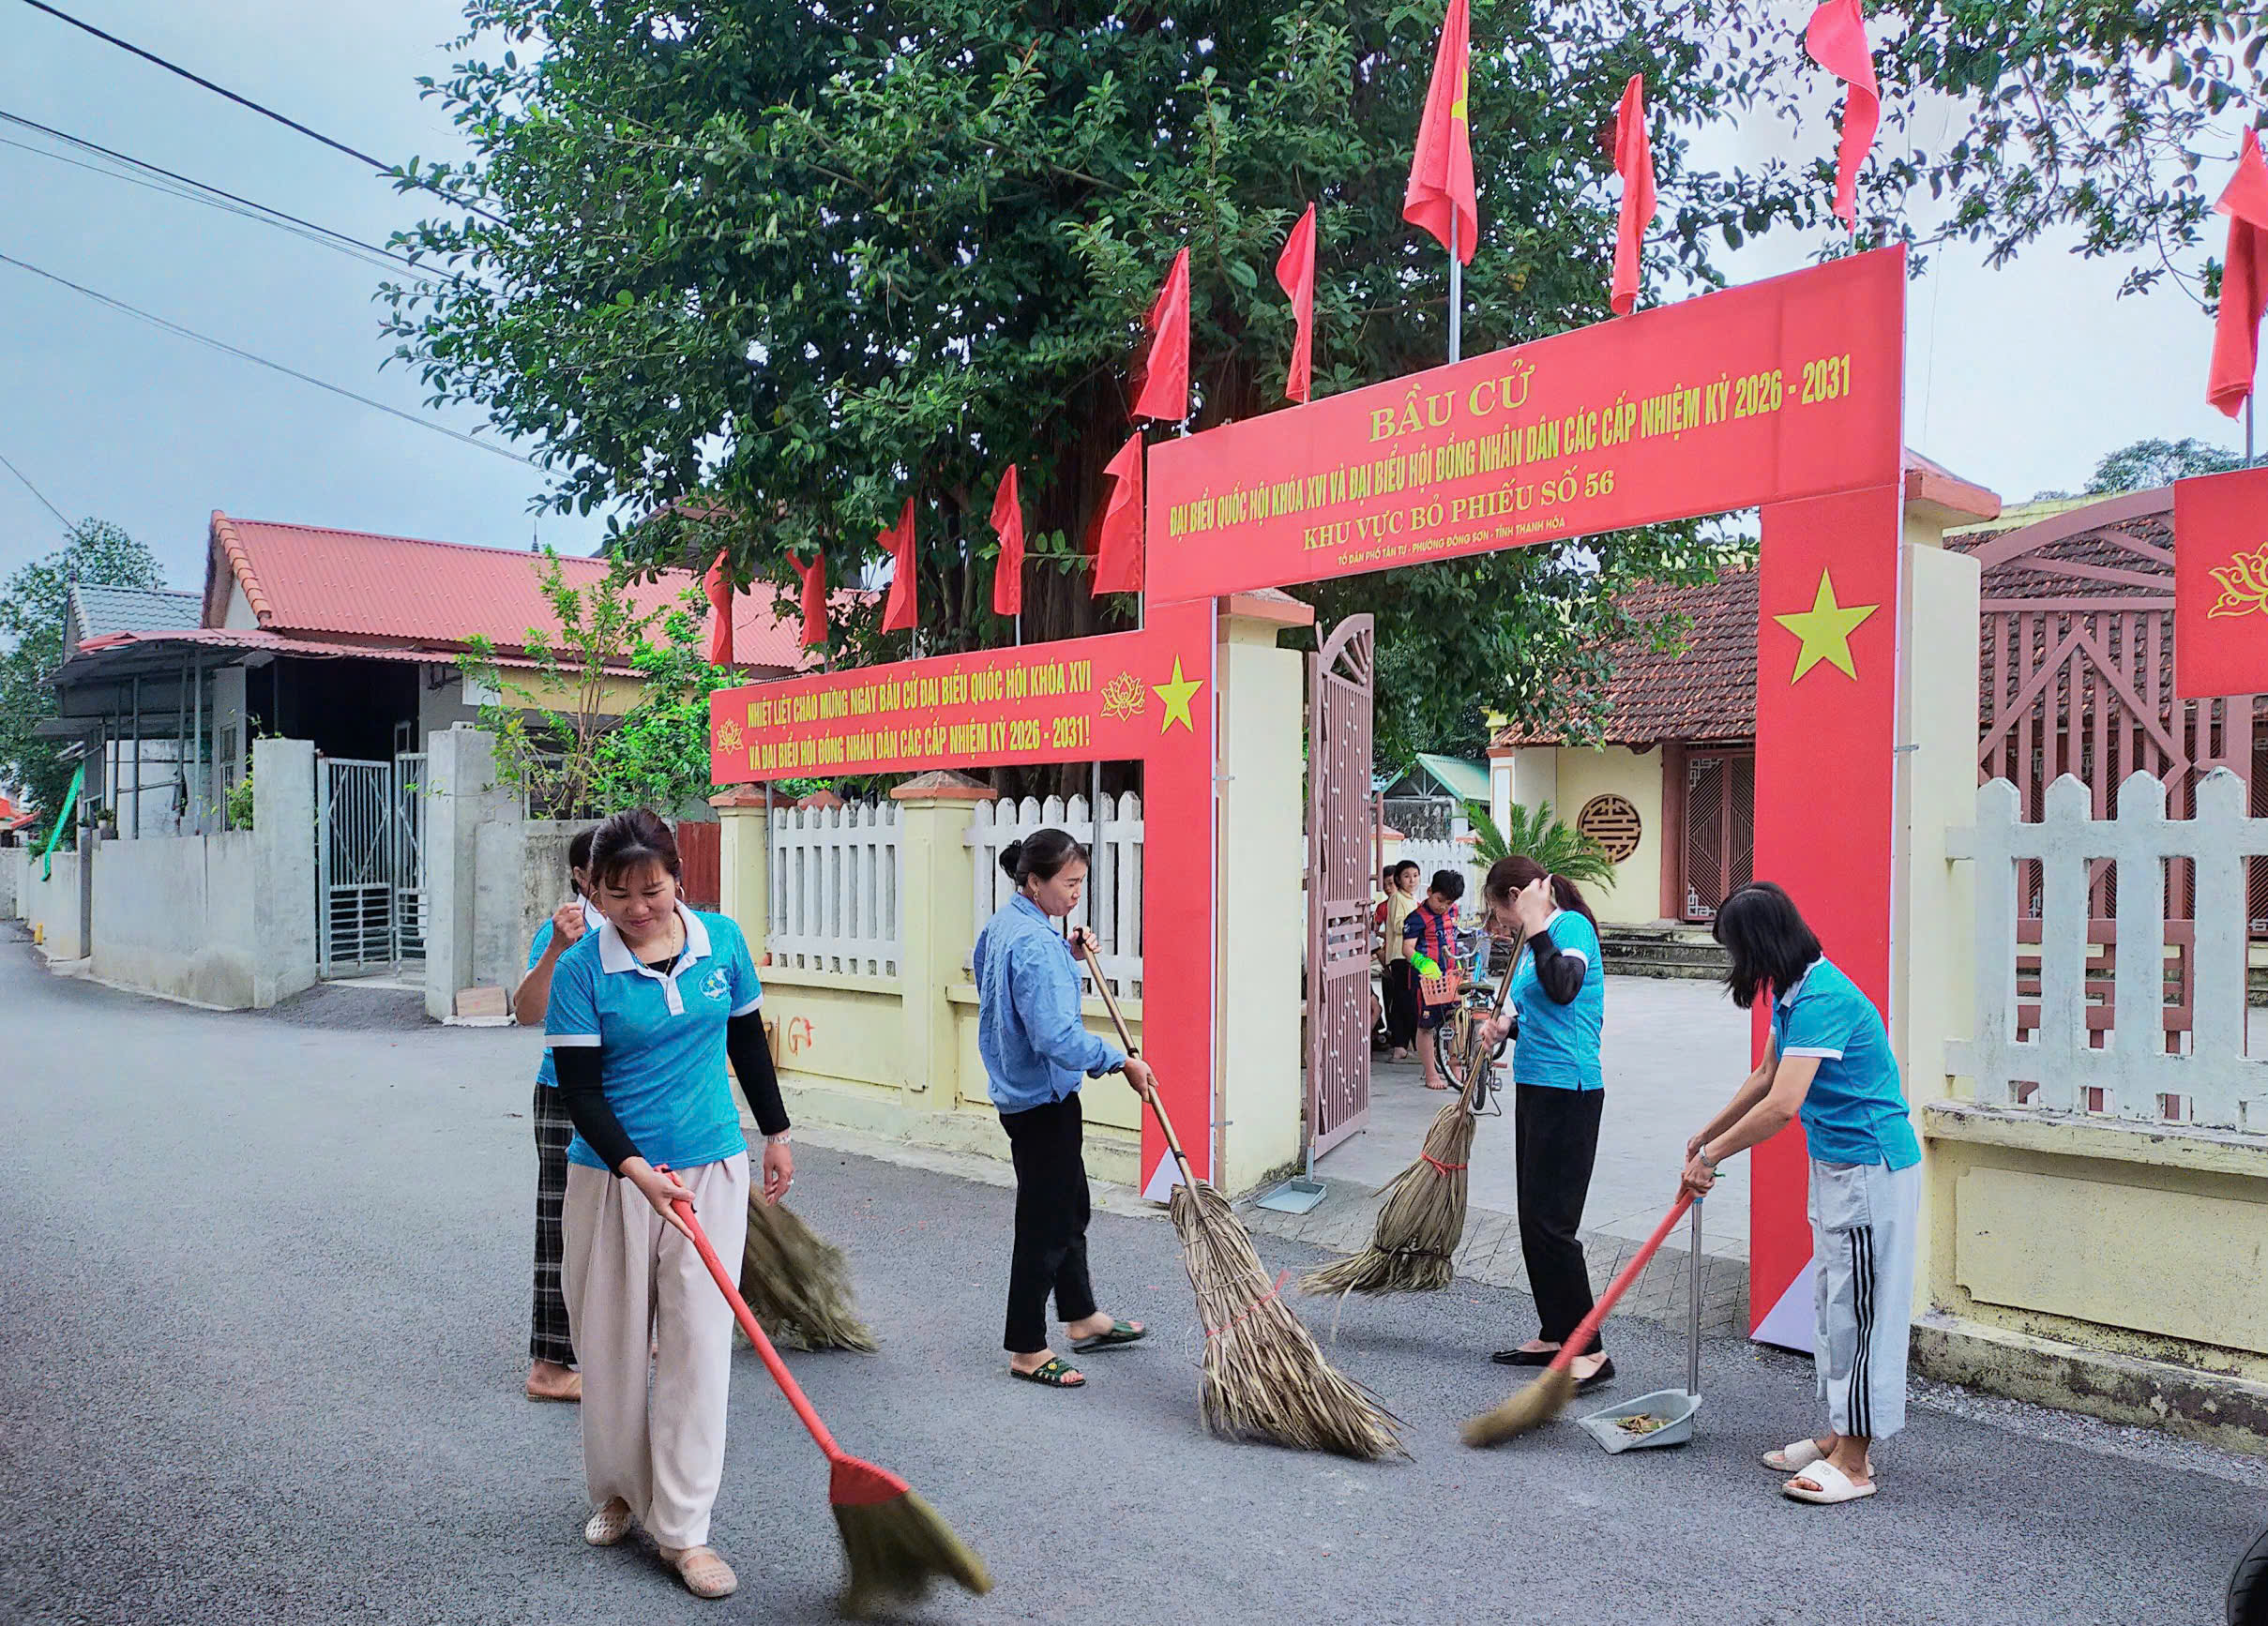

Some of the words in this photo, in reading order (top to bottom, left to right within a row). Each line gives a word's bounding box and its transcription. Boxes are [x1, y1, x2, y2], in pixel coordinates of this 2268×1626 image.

[1368, 383, 1456, 443] BẦU
[1469, 358, 1535, 416] CỬ
[1170, 504, 1188, 543] ĐẠI
[1189, 487, 1215, 533] BIỂU
[1217, 480, 1247, 531] QUỐC
[1249, 480, 1270, 527] HỘI
[1272, 474, 1304, 517] KHÓA
[1307, 474, 1327, 510] XVI
[1329, 462, 1346, 504] VÀ
[1349, 463, 1372, 506] ĐẠI
[1374, 442, 1406, 495] BIỂU
[1409, 442, 1432, 494] HỘI
[1435, 431, 1475, 482] ĐỒNG
[1479, 423, 1522, 473] NHÂN
[1526, 414, 1561, 464] DÂN
[1564, 405, 1597, 456] CÁC
[1601, 390, 1637, 447] CẤP
[1641, 383, 1701, 441] NHIỆM
[1705, 372, 1731, 426] KỲ
[1734, 369, 1782, 419] 2026
[1788, 384, 1796, 395] -
[1801, 354, 1851, 405] 2031
[1303, 521, 1351, 550] KHU
[1356, 509, 1404, 543] VỰC
[1410, 493, 1444, 531] BỎ
[1450, 478, 1535, 523] PHIẾU
[1540, 465, 1578, 506] SỐ
[1583, 470, 1614, 498] 56
[1348, 550, 1364, 564] DÂN
[1366, 545, 1381, 562] PHỐ
[1472, 530, 1489, 543] SƠN
[1516, 520, 1544, 535] THANH
[1546, 514, 1565, 530] HÓA
[748, 696, 772, 732] NHIỆT
[773, 693, 793, 730] LIỆT
[793, 690, 818, 724] CHÀO
[820, 685, 848, 720] MỪNG
[851, 681, 877, 715] NGÀY
[879, 673, 900, 713] BẦU
[902, 670, 918, 710] CỬ
[920, 677, 939, 713] ĐẠI
[942, 663, 968, 705] BIỂU
[970, 660, 1003, 705] QUỐC
[1005, 660, 1028, 705] HỘI
[1030, 656, 1066, 698] KHÓA
[1068, 659, 1091, 693] XVI
[749, 740, 761, 771] VÀ
[762, 743, 777, 775] ĐẠI
[778, 731, 799, 769] BIỂU
[800, 733, 817, 772] HỘI
[846, 727, 874, 762] NHÂN
[876, 725, 898, 760] DÂN
[900, 723, 922, 759] CÁC
[924, 716, 947, 756] CẤP
[949, 716, 988, 760] NHIỆM
[990, 715, 1006, 752] KỲ
[1009, 719, 1041, 751] 2026
